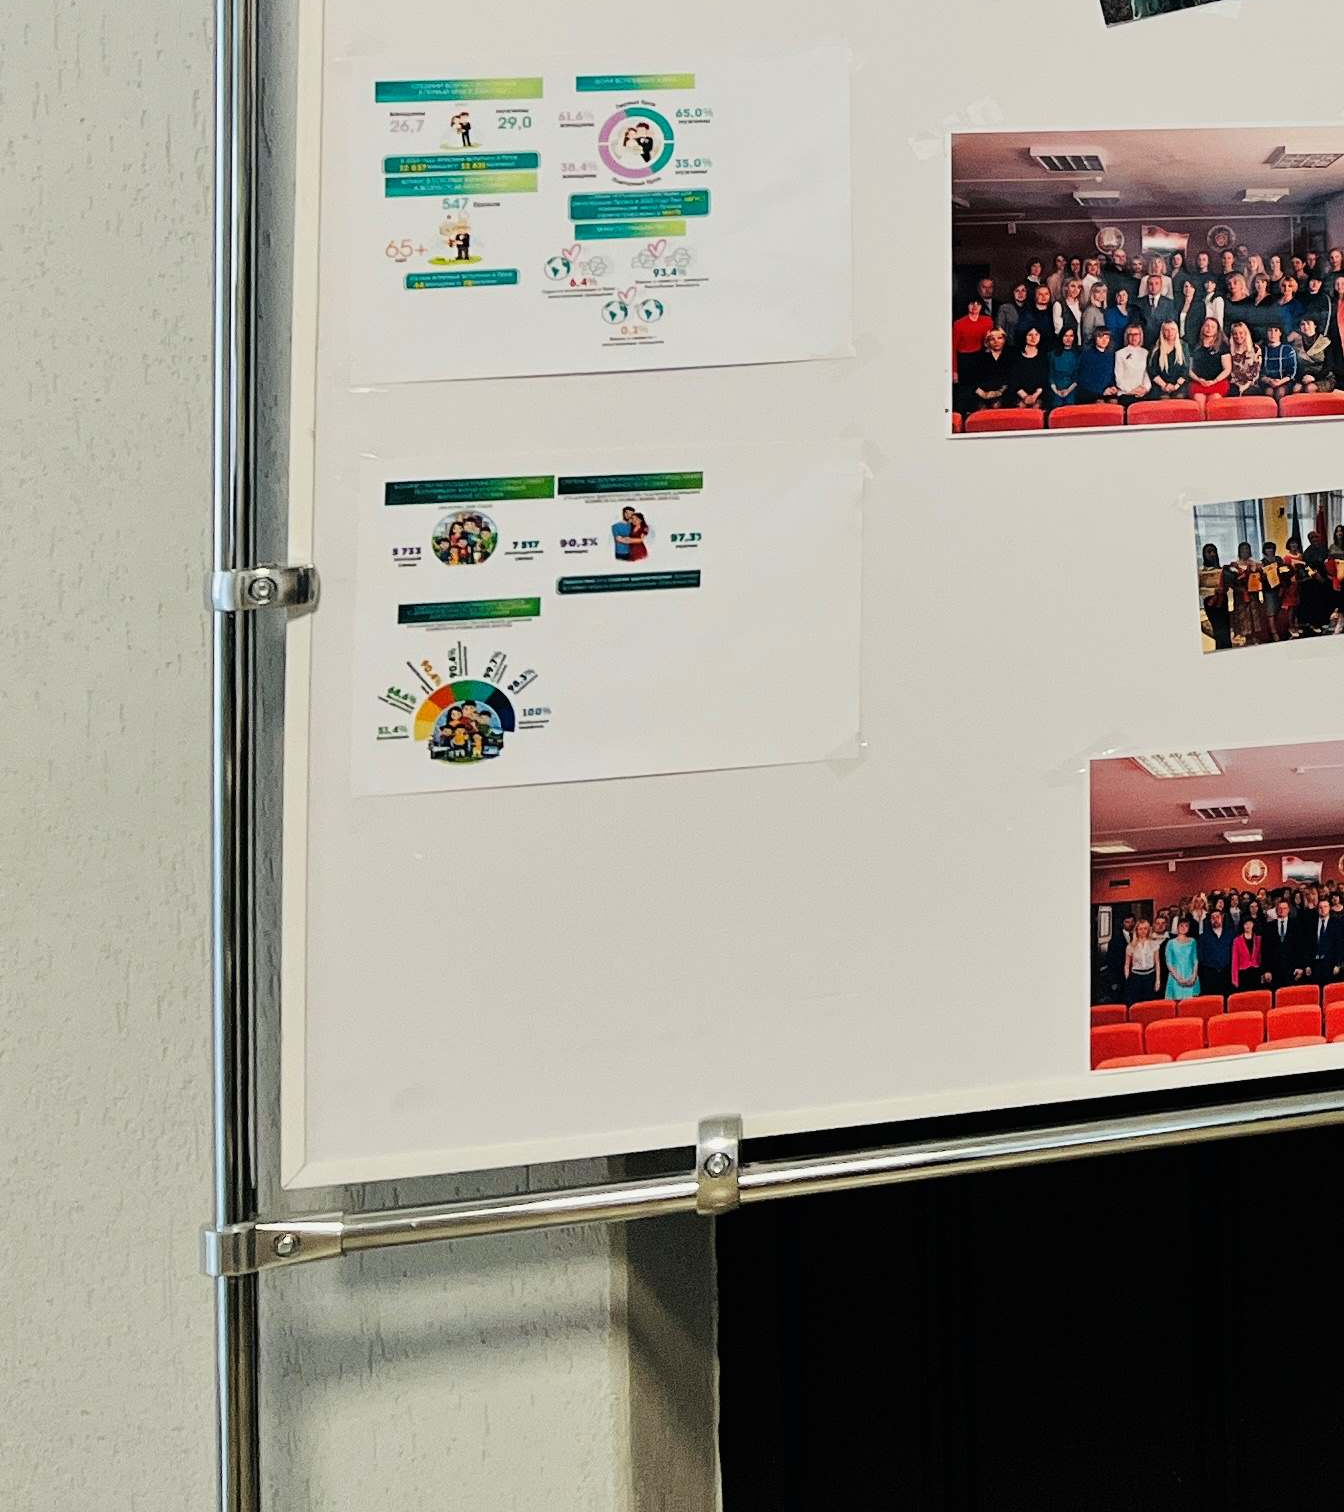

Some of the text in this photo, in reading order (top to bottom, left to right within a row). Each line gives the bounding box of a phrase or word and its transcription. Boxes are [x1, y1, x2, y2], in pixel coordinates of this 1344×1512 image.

[389, 119, 425, 134] 26,7
[497, 115, 532, 130] 29,0
[442, 198, 469, 210] 547
[385, 238, 428, 258] 65+
